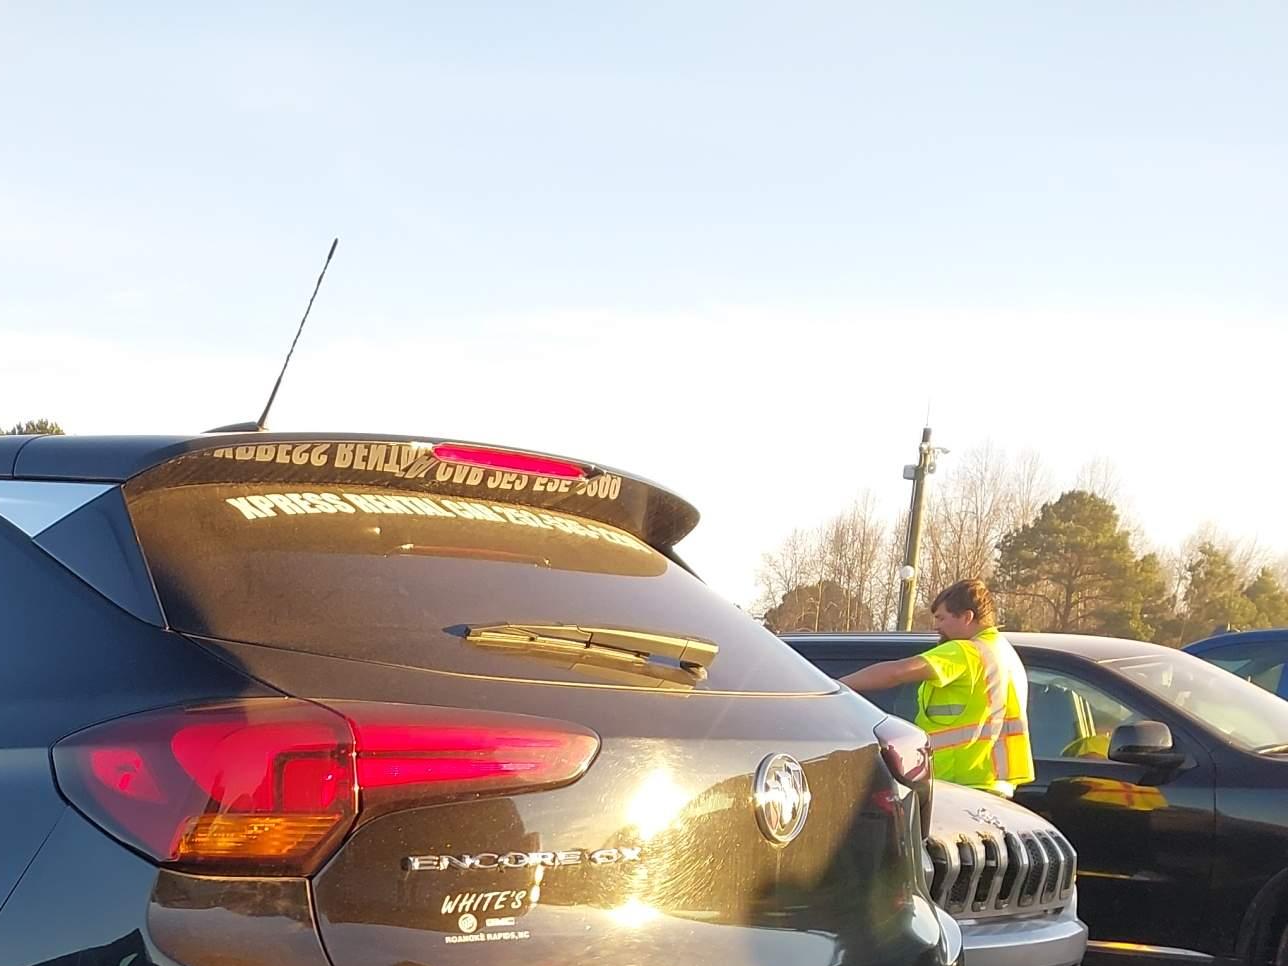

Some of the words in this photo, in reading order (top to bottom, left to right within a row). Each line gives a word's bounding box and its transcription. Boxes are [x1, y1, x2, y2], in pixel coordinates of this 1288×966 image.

[226, 492, 356, 520] XPRESS
[343, 493, 457, 518] RENTAL
[409, 848, 581, 871] ENCORE
[589, 846, 642, 866] GX
[441, 890, 527, 915] WHITE'S
[445, 932, 486, 944] ROANOKE
